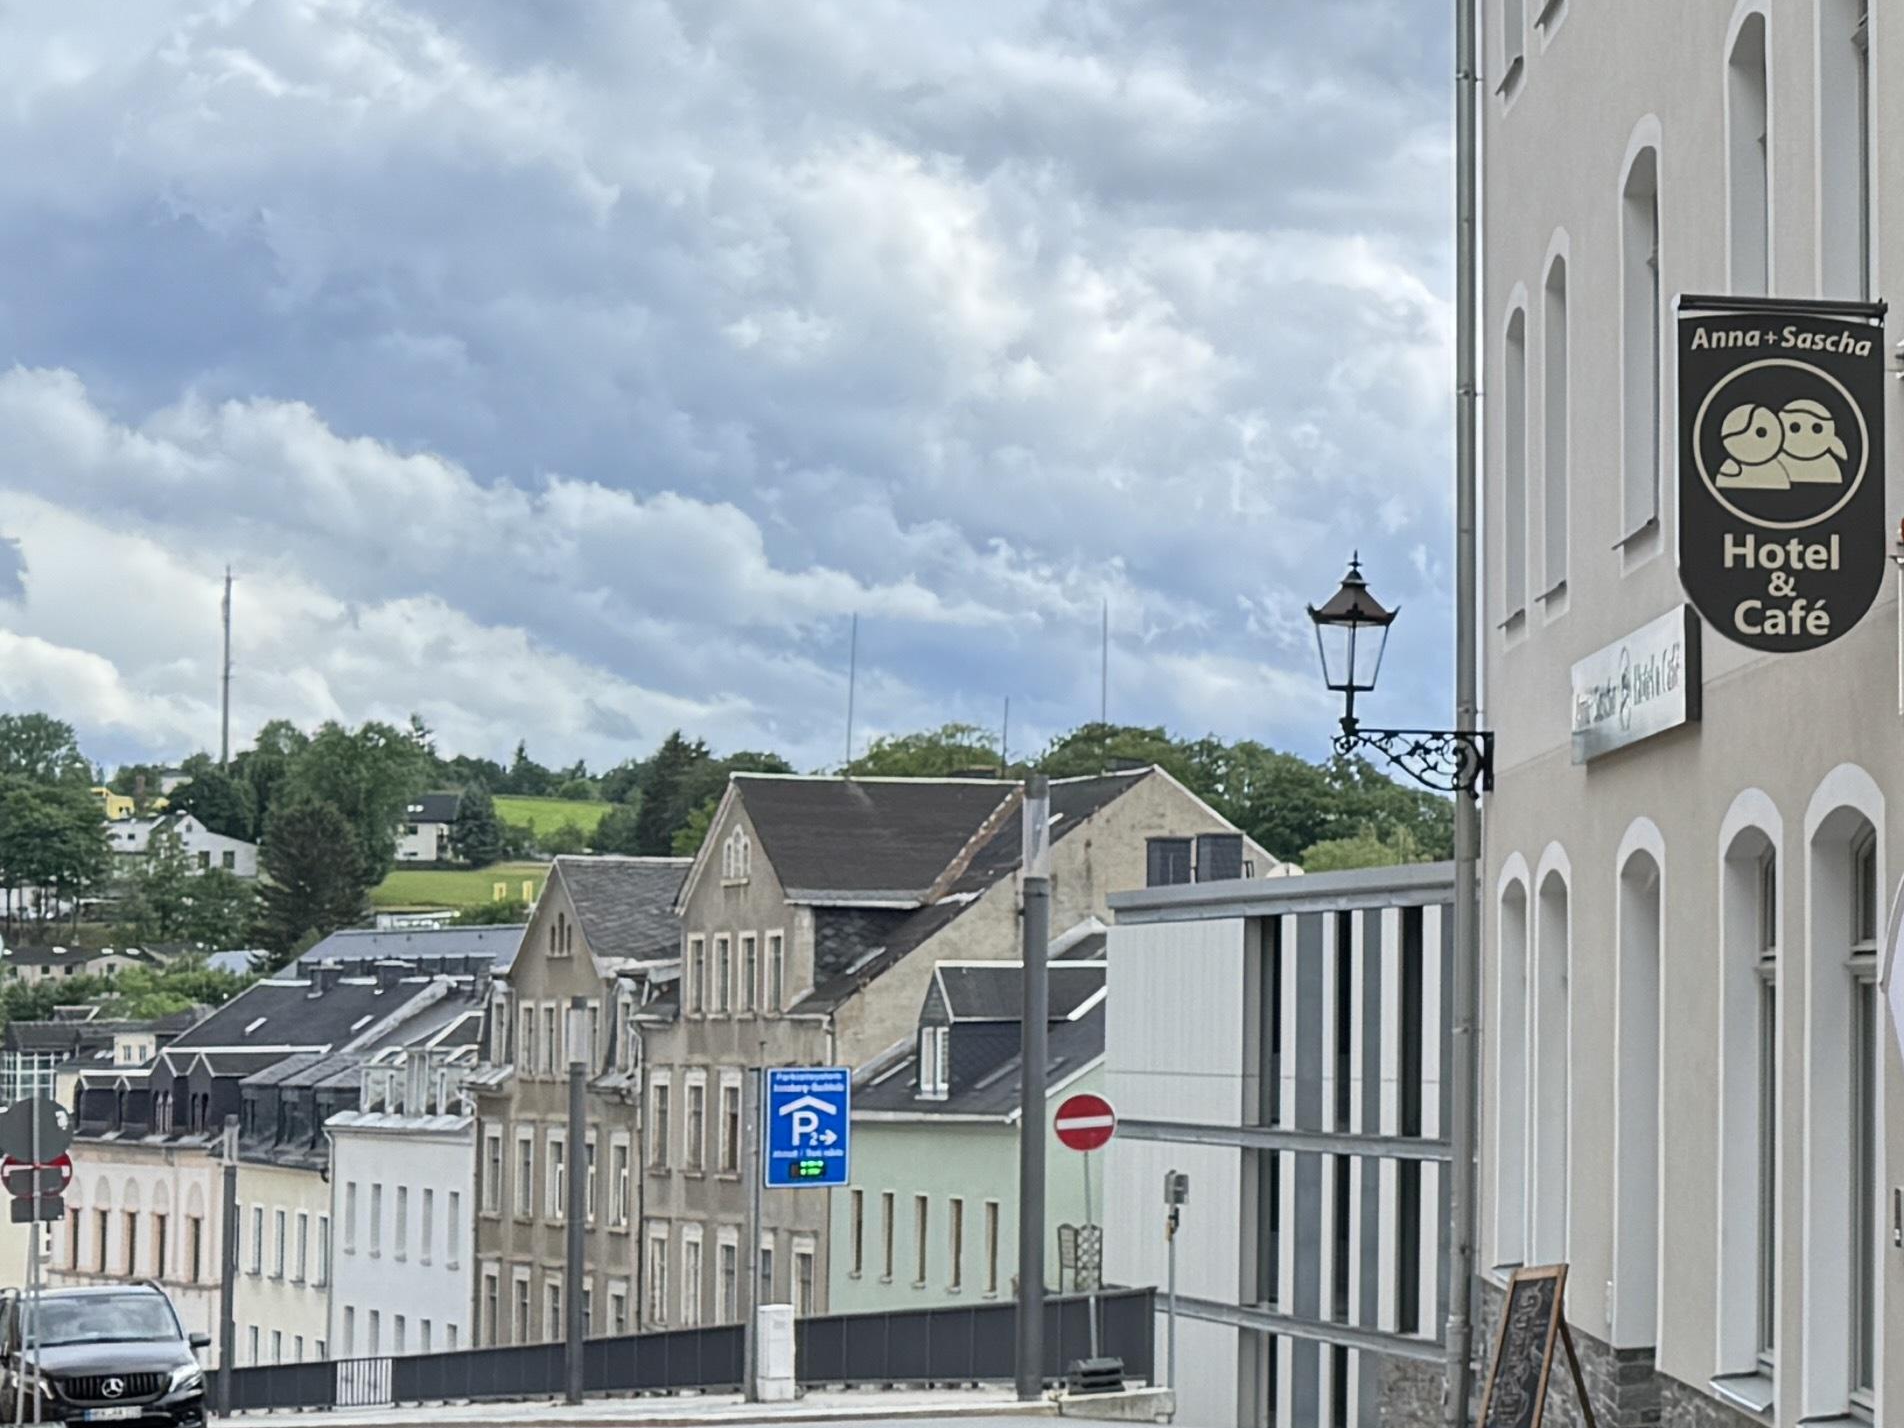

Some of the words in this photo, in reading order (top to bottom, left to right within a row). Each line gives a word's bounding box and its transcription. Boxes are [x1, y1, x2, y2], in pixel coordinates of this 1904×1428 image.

[1723, 534, 1841, 571] Hotel
[1767, 571, 1797, 597] &
[1733, 599, 1831, 636] Café
